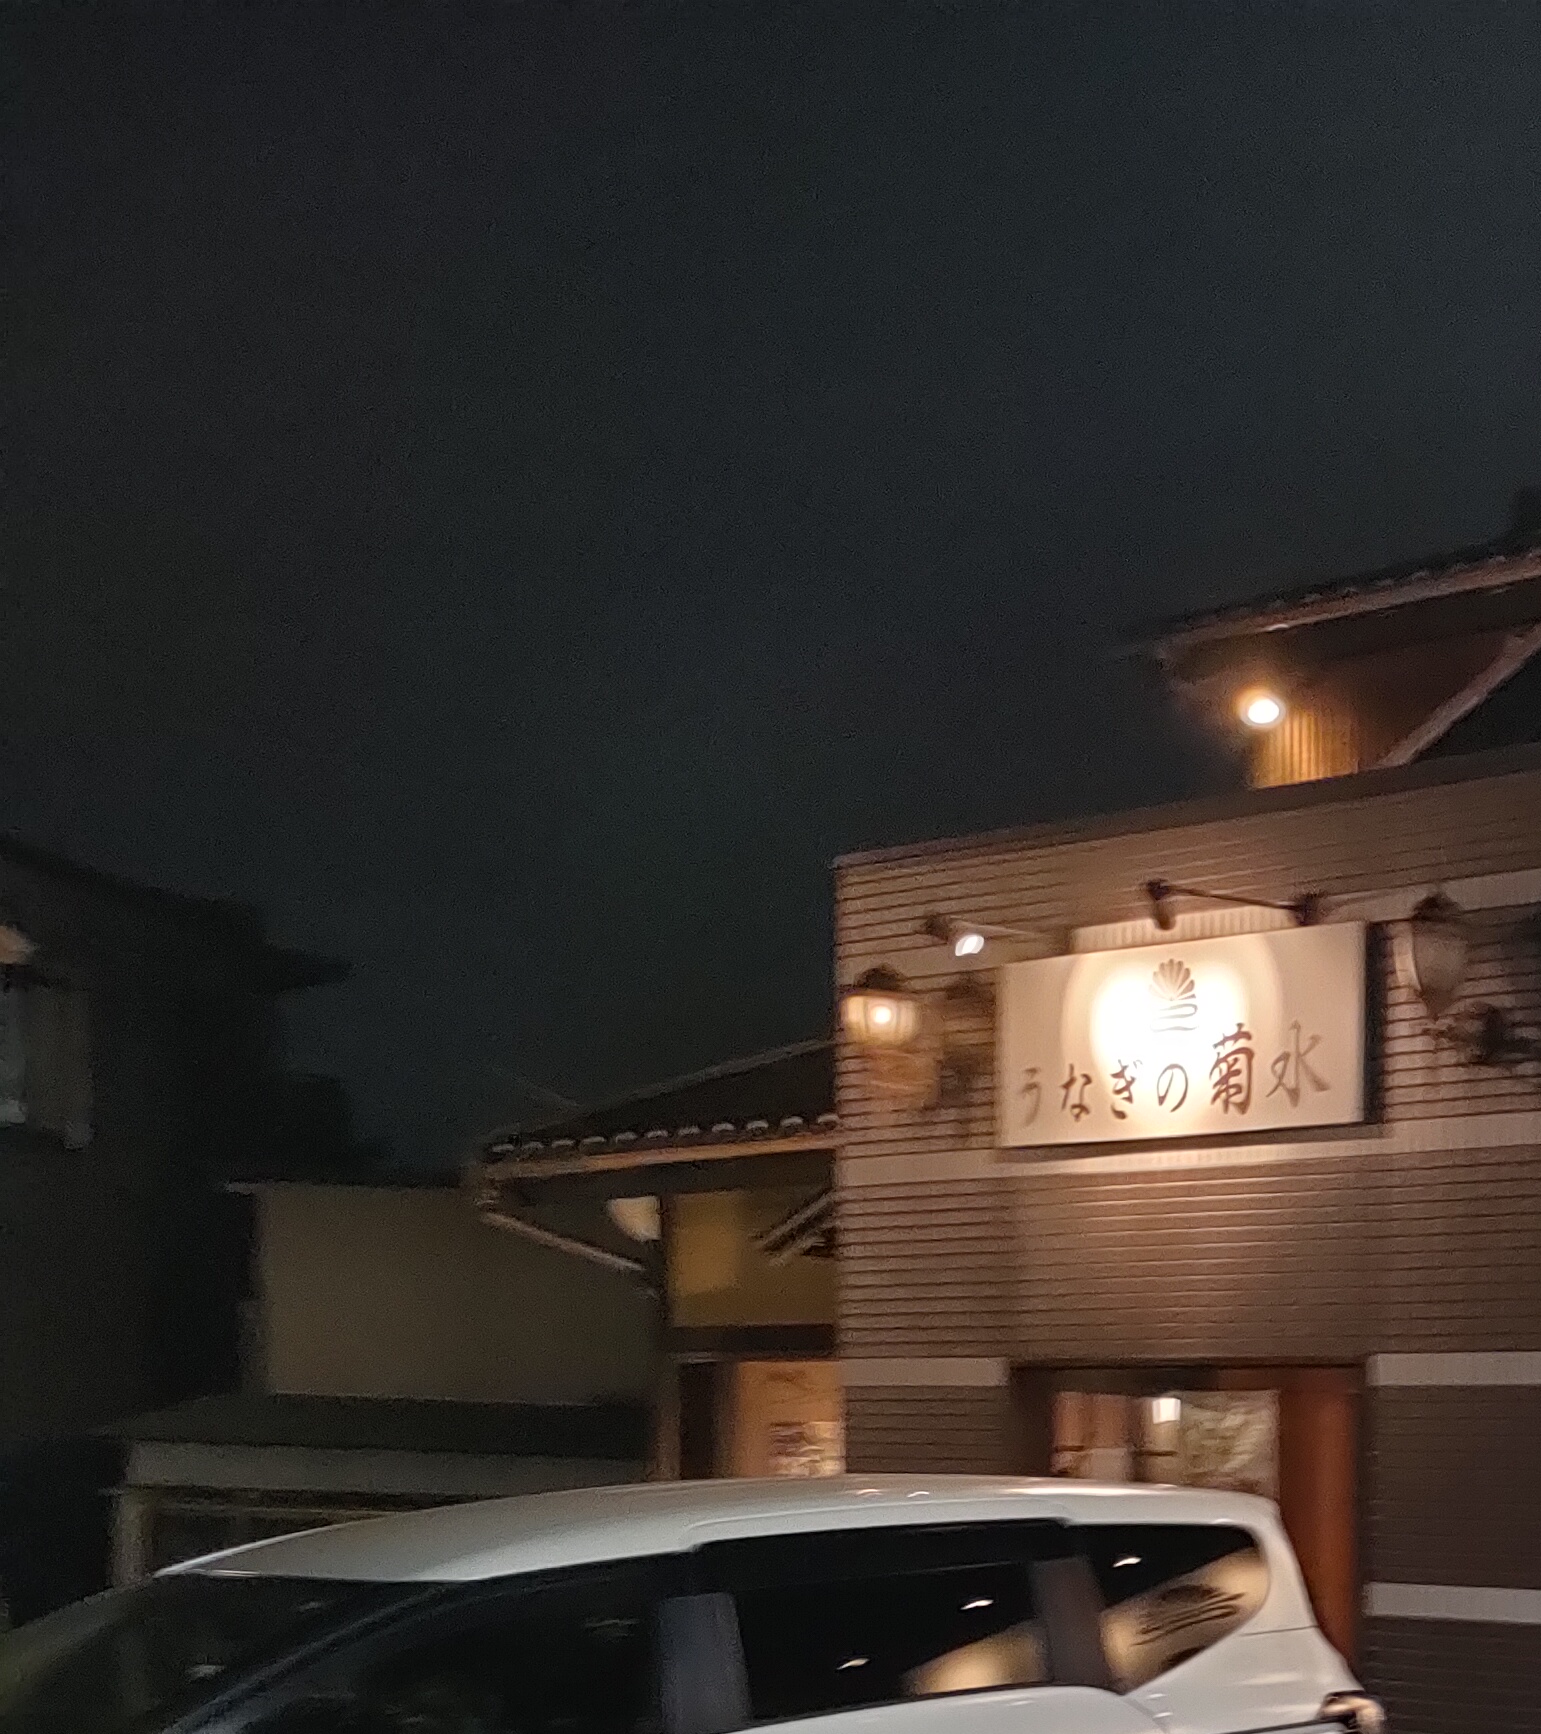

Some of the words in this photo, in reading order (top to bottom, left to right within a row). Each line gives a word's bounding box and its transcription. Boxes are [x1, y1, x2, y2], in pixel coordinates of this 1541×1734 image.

[1021, 1020, 1332, 1128] うなぎの菊水
